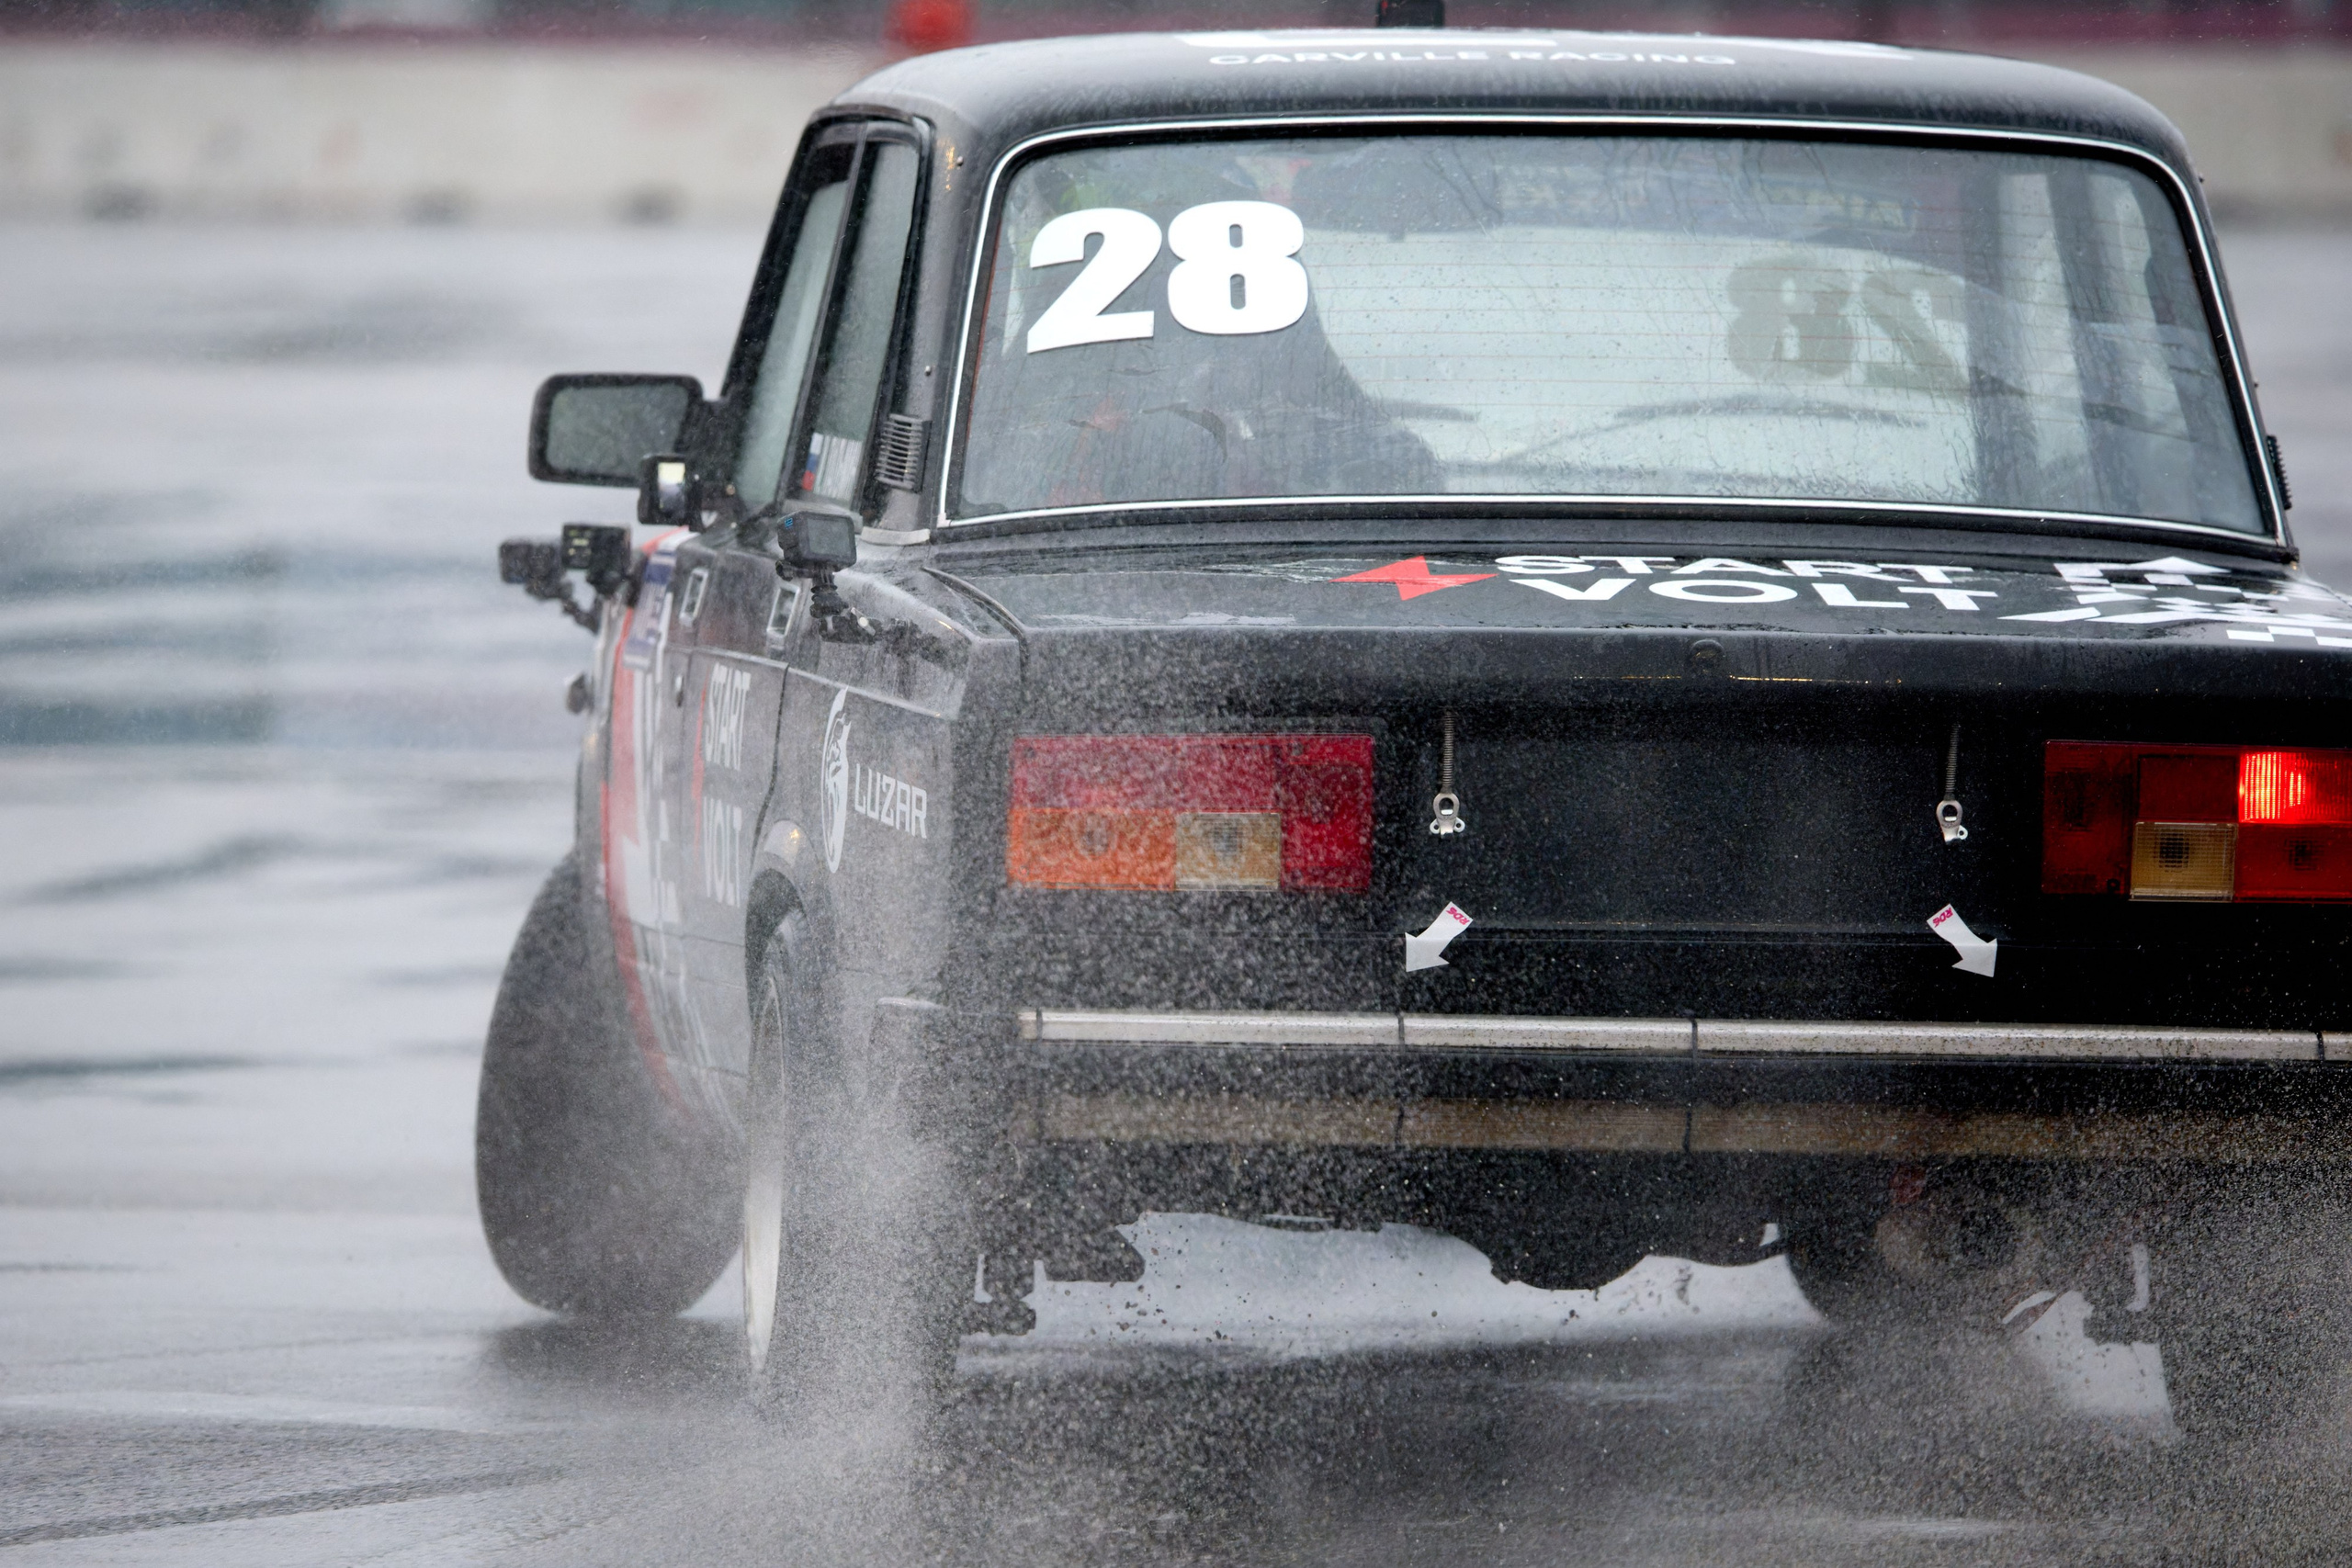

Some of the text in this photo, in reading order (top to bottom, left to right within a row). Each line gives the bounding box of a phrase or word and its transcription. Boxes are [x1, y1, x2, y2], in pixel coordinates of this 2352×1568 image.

[1509, 51, 1736, 65] RACING
[1027, 200, 1308, 355] 28
[1495, 555, 1973, 584] START
[1509, 578, 1999, 611] VOLT
[705, 661, 752, 771] START
[855, 763, 927, 840] LUZAR
[703, 795, 742, 908] VOLT
